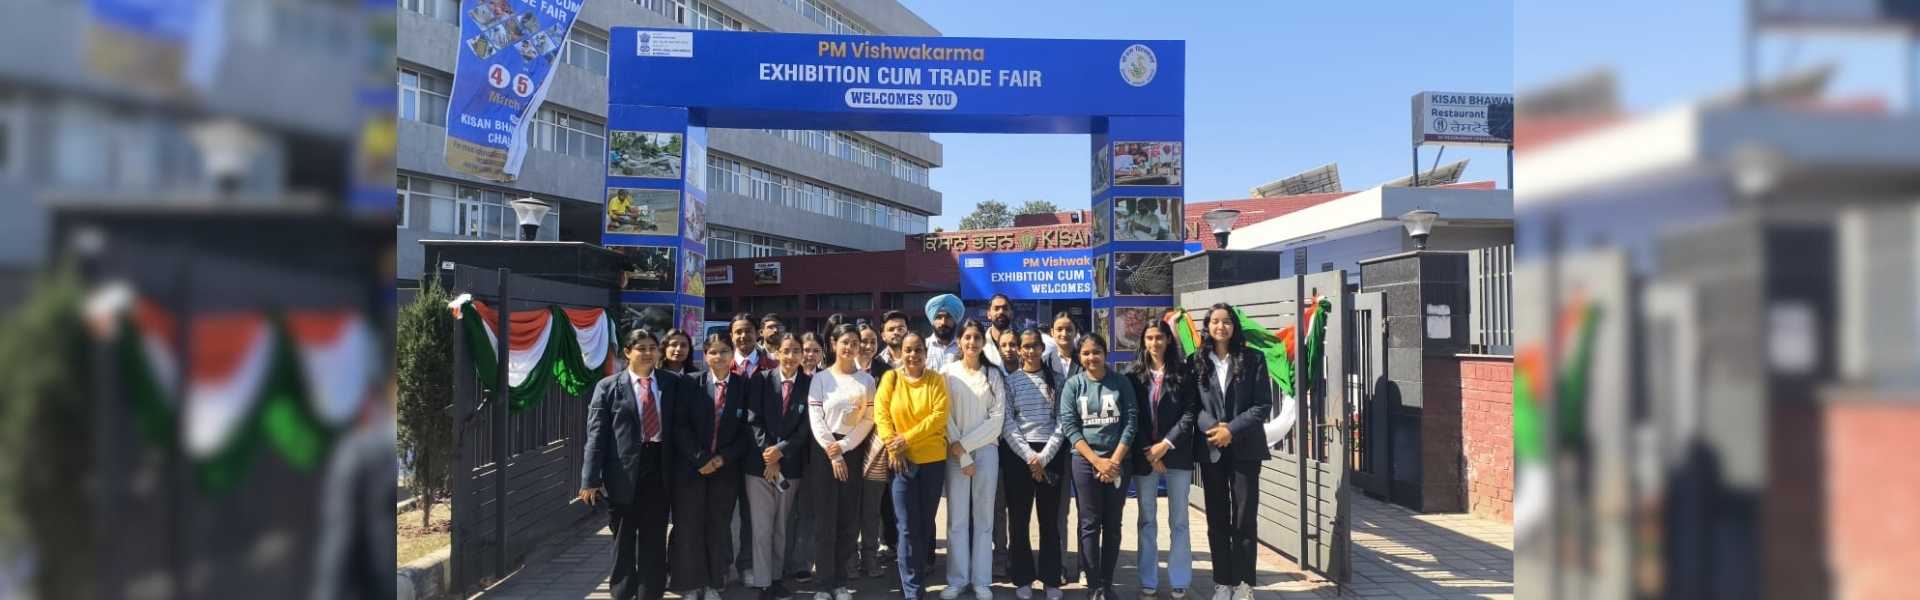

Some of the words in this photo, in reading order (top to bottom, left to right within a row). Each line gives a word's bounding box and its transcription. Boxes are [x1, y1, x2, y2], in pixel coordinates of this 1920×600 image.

[541, 0, 567, 22] FAIR
[818, 40, 847, 58] PM
[851, 41, 985, 62] Vishwakarma
[490, 66, 503, 86] 4
[517, 75, 529, 95] 5
[759, 62, 870, 84] EXHIBITION
[877, 66, 921, 85] CUM
[928, 68, 992, 87] TRADE
[998, 70, 1042, 87] FAIR
[488, 91, 520, 112] March
[850, 90, 923, 105] WELCOMES
[928, 94, 952, 106] YOU
[1431, 94, 1466, 105] KISAN
[461, 113, 492, 129] KISAN
[1431, 108, 1485, 118] Restaurant
[1023, 257, 1040, 267] PM
[1041, 255, 1090, 268] Vishwak
[991, 271, 1054, 282] EXHIBITION
[1057, 270, 1085, 281] CUM
[1031, 282, 1091, 294] WELCOMES
[1079, 394, 1121, 419] LA
